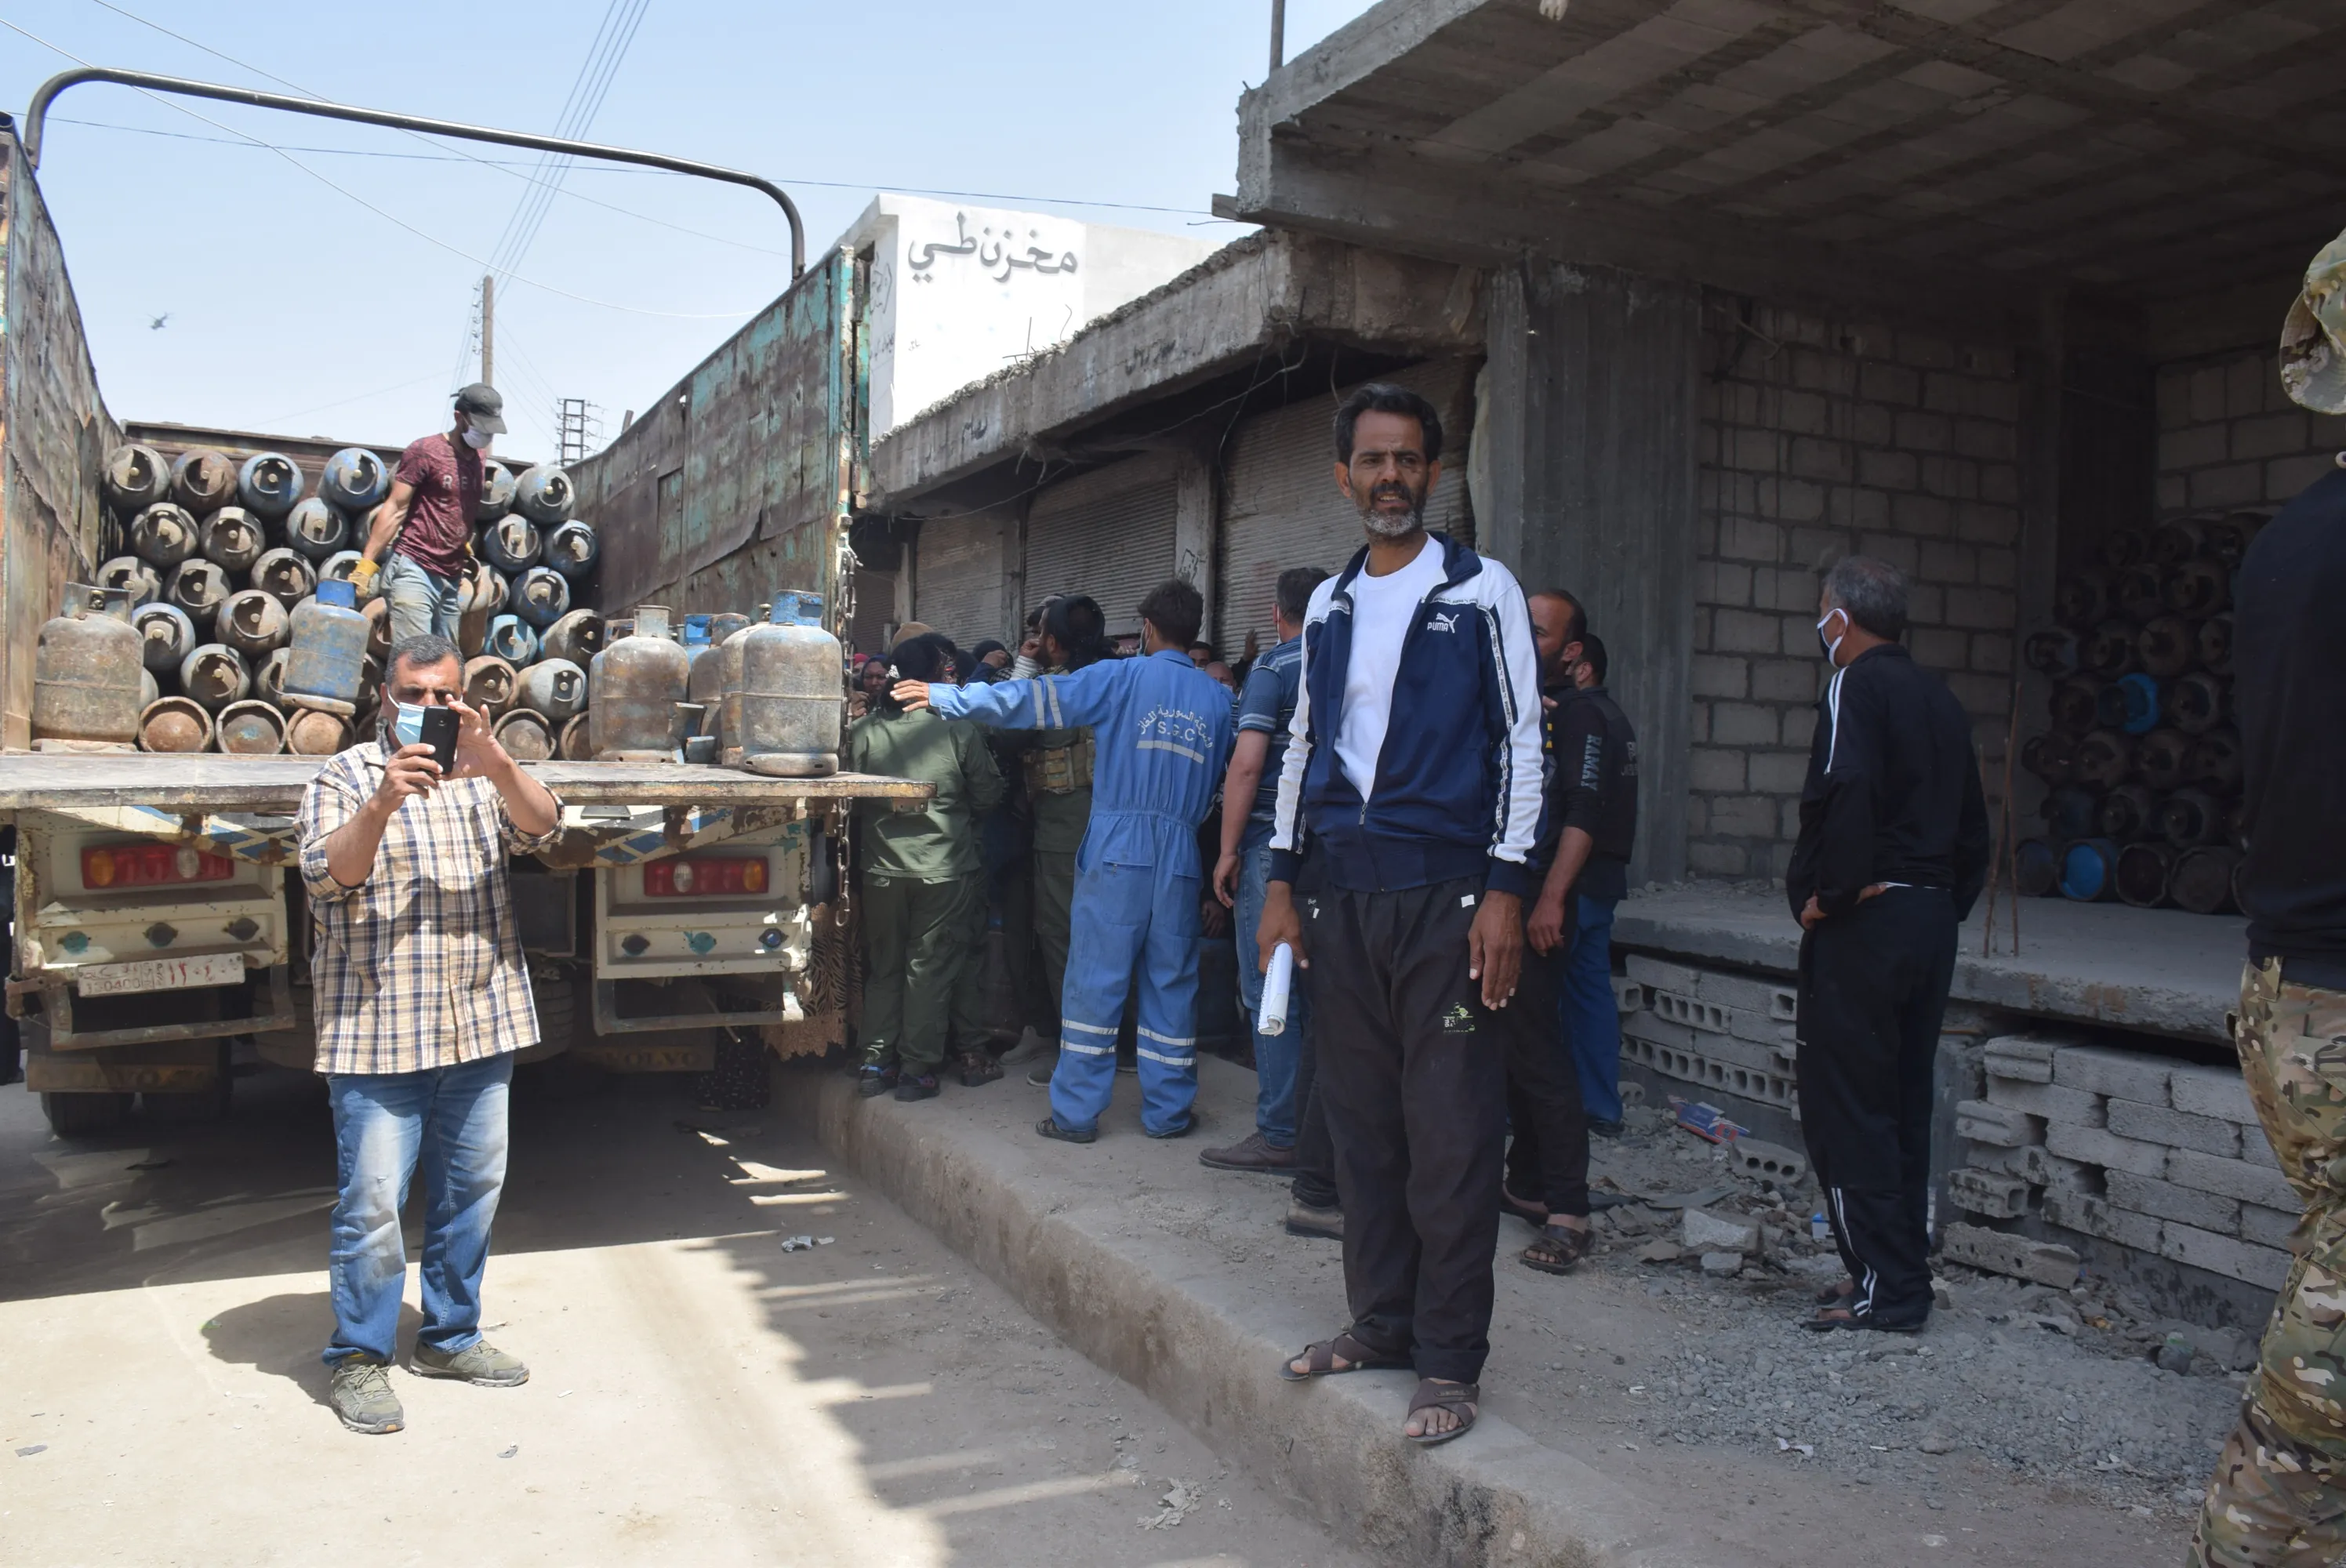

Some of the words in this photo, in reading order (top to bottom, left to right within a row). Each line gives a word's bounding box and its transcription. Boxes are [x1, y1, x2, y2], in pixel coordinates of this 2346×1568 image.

[980, 227, 1078, 283] مخزن
[1427, 622, 1449, 632] PUMA
[1138, 710, 1157, 735] للغاز
[1157, 704, 1194, 721] السورية
[1157, 720, 1196, 742] S.G.C
